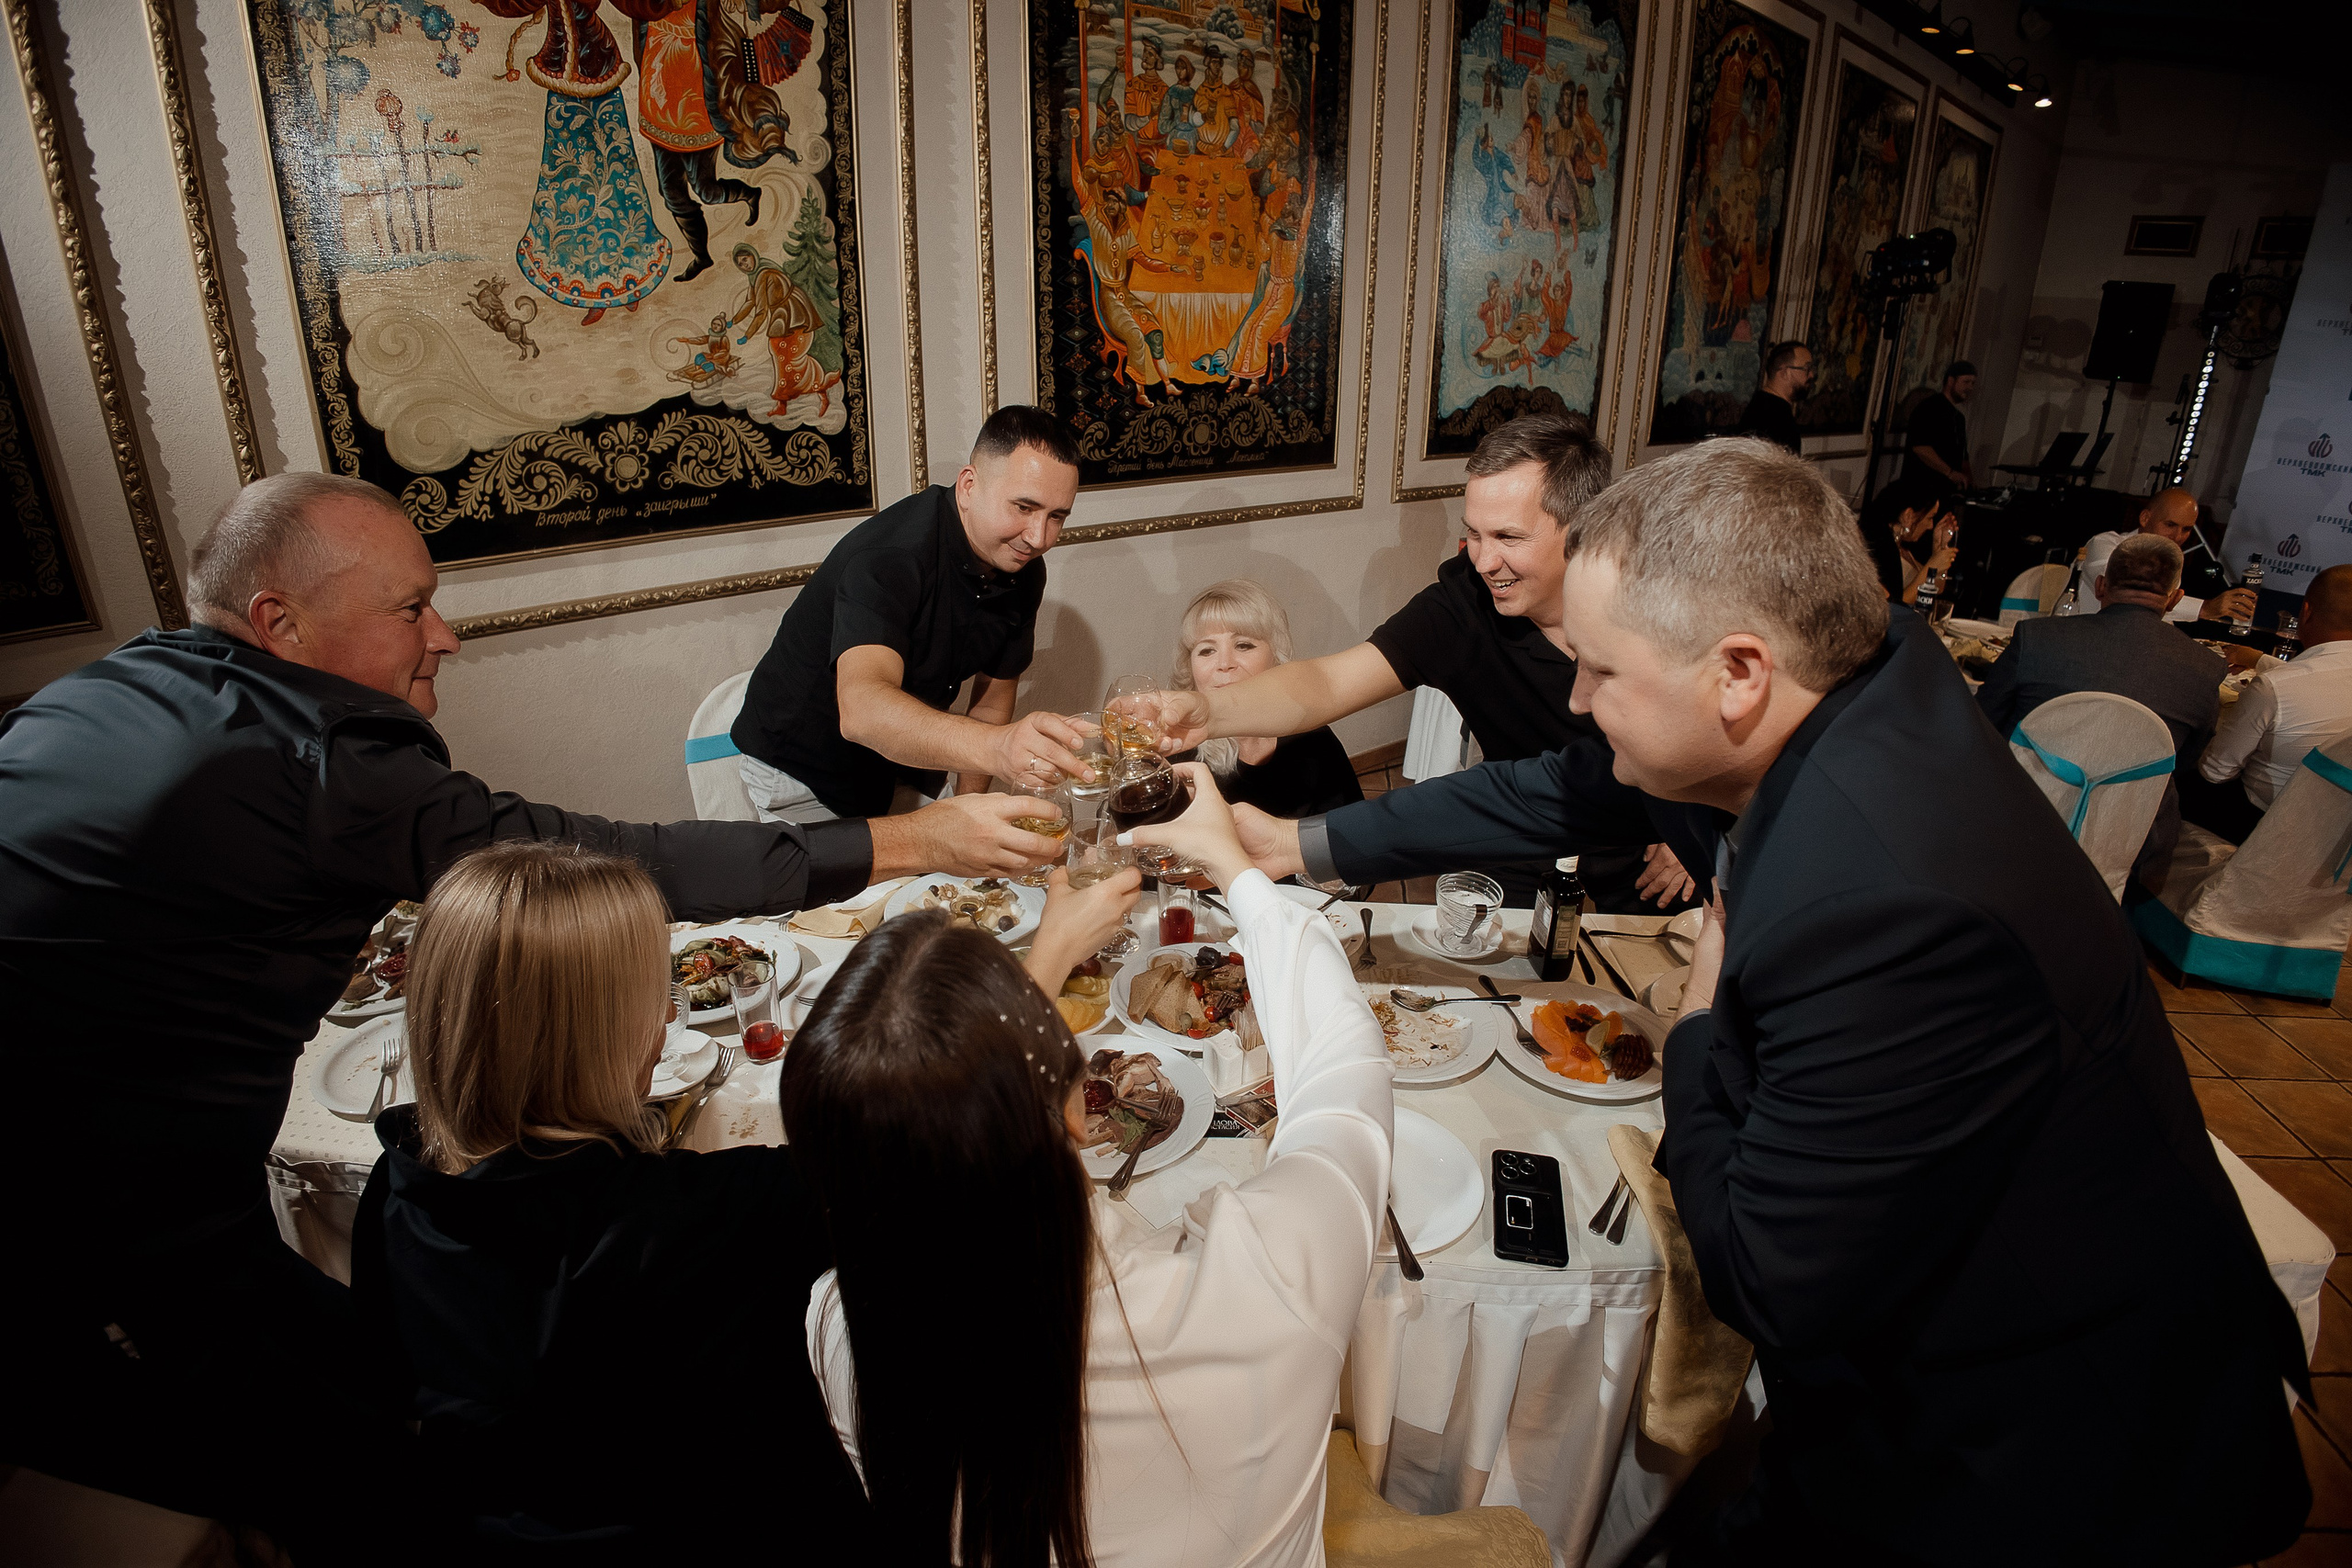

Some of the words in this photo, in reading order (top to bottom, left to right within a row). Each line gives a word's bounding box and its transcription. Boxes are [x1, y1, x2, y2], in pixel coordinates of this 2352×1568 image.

[1146, 457, 1165, 470] день
[2301, 468, 2326, 478] ТМК
[535, 505, 592, 528] Второй
[596, 504, 628, 525] день
[2269, 566, 2295, 577] ТМК
